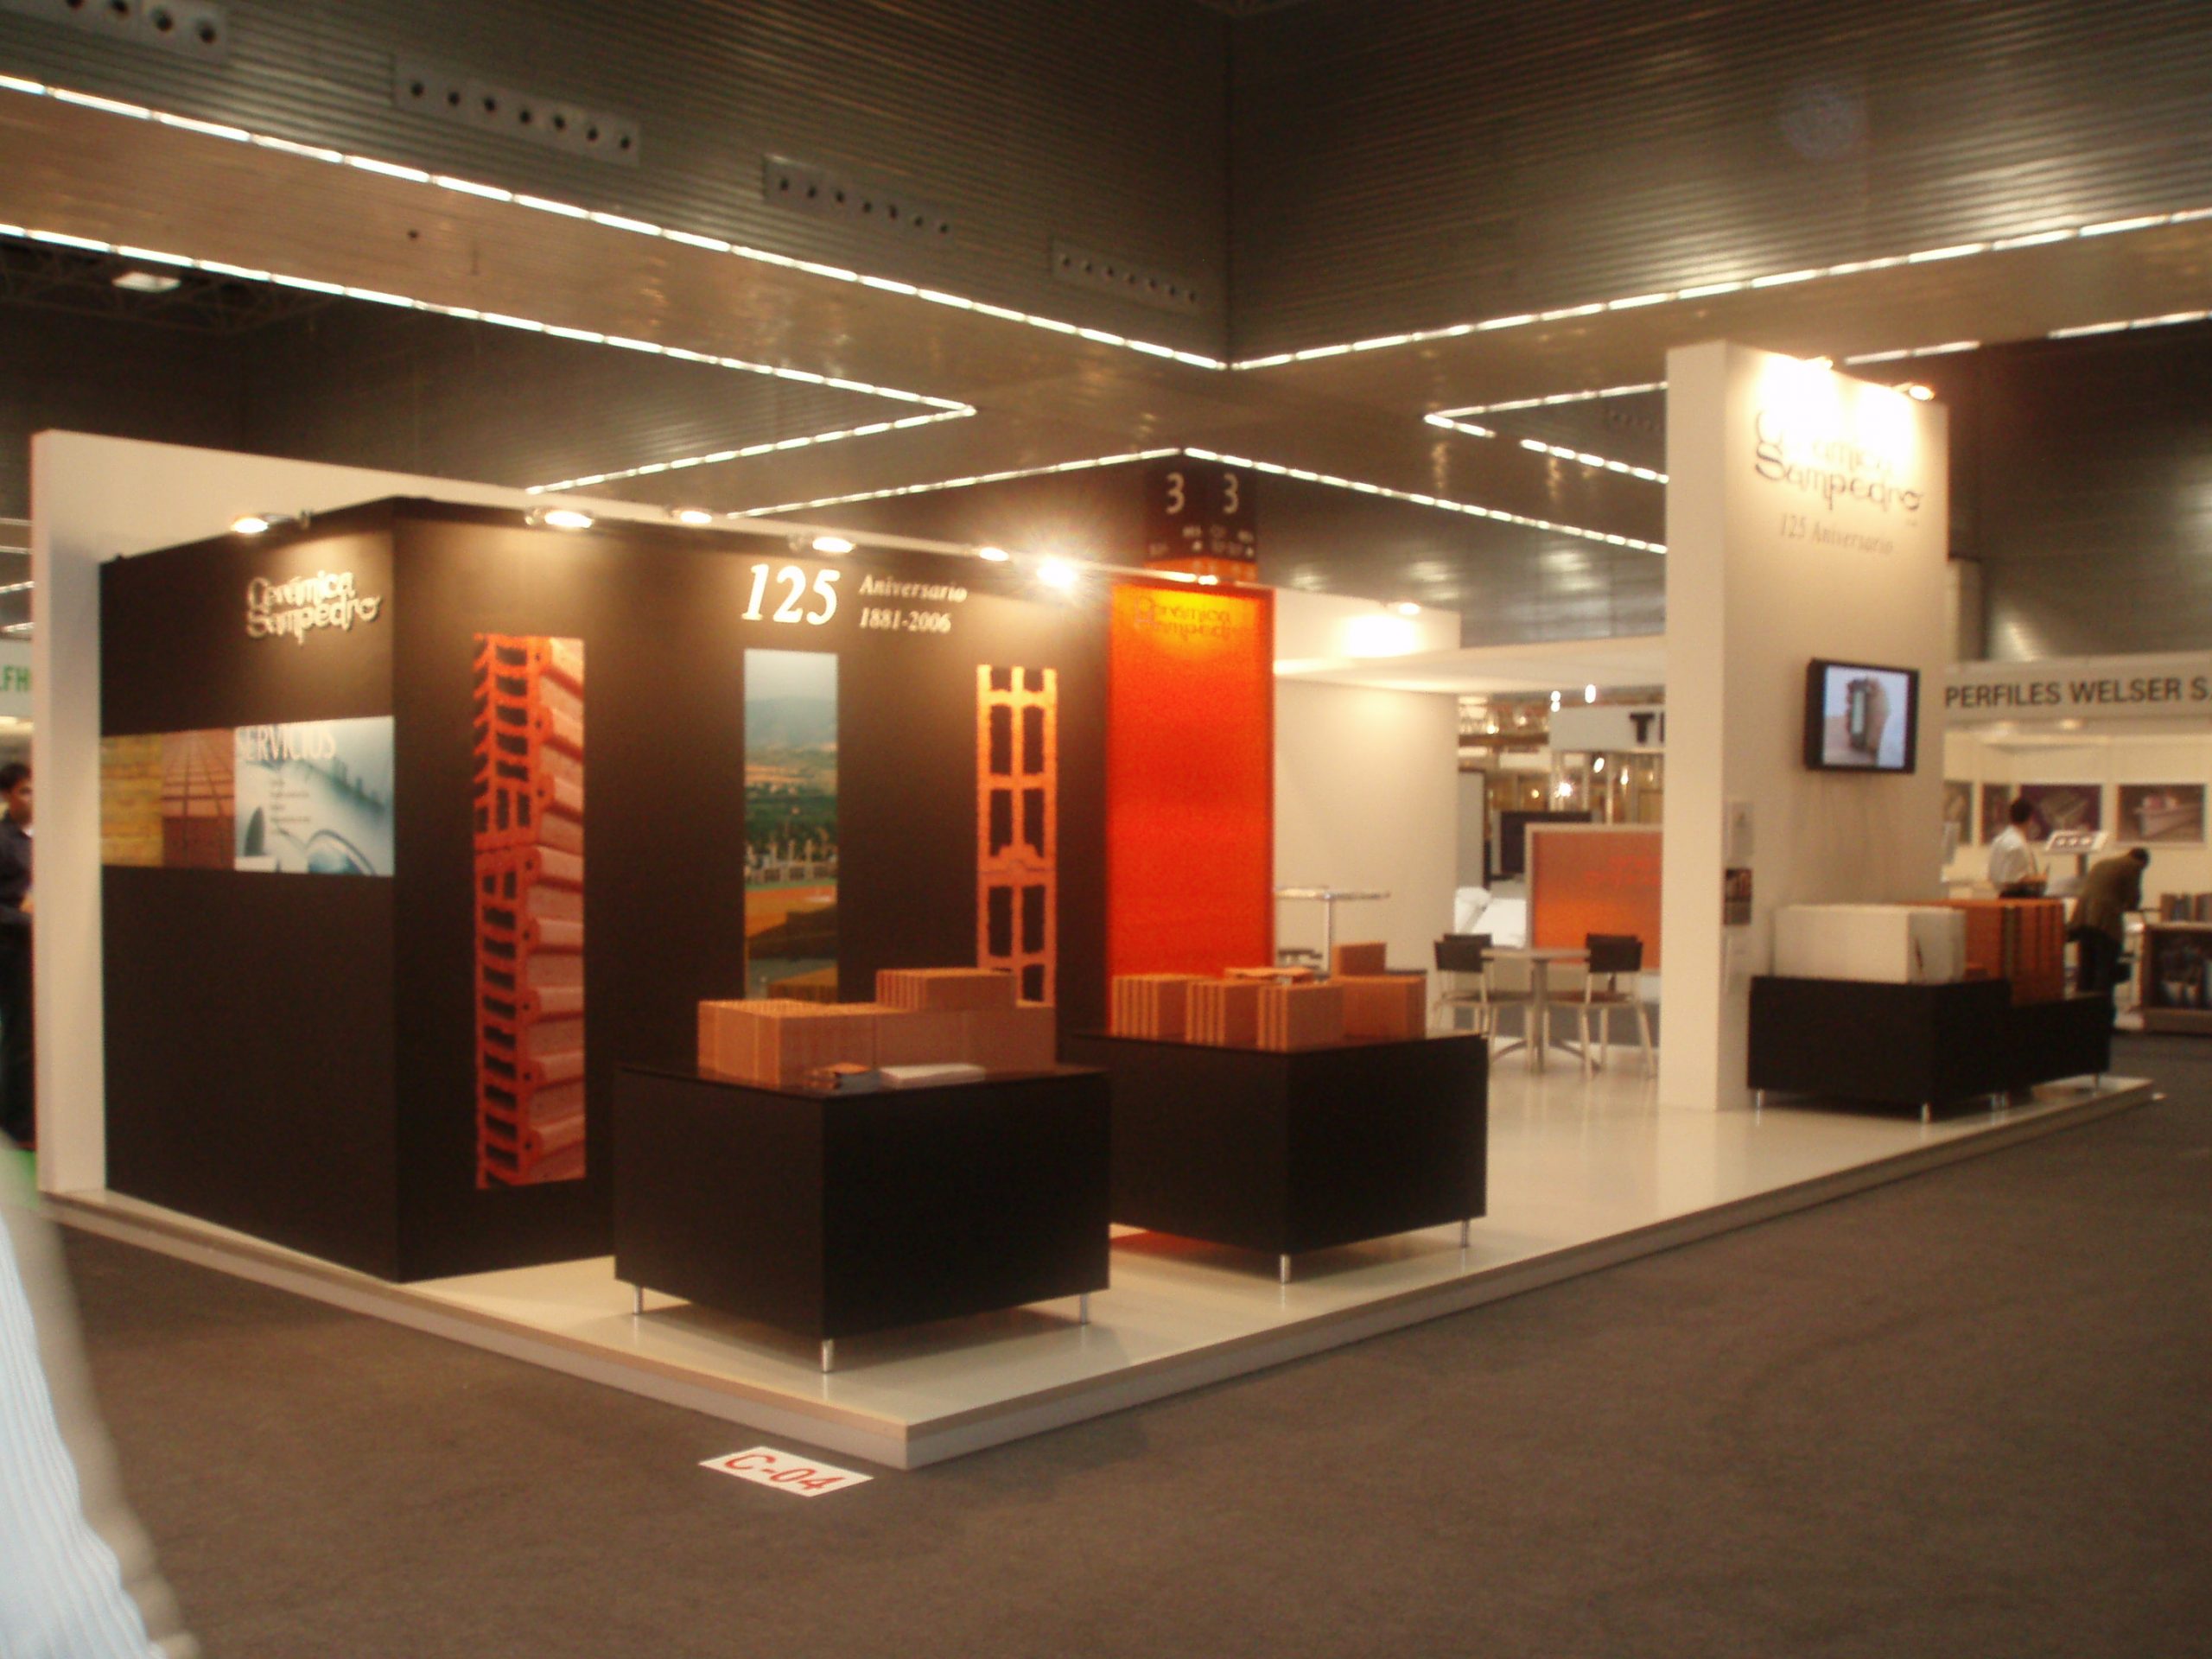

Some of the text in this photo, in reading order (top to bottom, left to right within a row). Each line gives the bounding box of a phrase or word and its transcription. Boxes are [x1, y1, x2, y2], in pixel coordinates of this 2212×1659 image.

[1166, 472, 1185, 514] 3
[1224, 472, 1239, 514] 3
[1781, 513, 1805, 538] 125
[741, 563, 968, 626] 125 Aniversario
[246, 594, 383, 645] Sampedro
[860, 607, 951, 633] 1881-2006
[1945, 681, 2062, 708] PERFILES
[2069, 677, 2182, 703] WELSER
[724, 1453, 846, 1491] C-04
